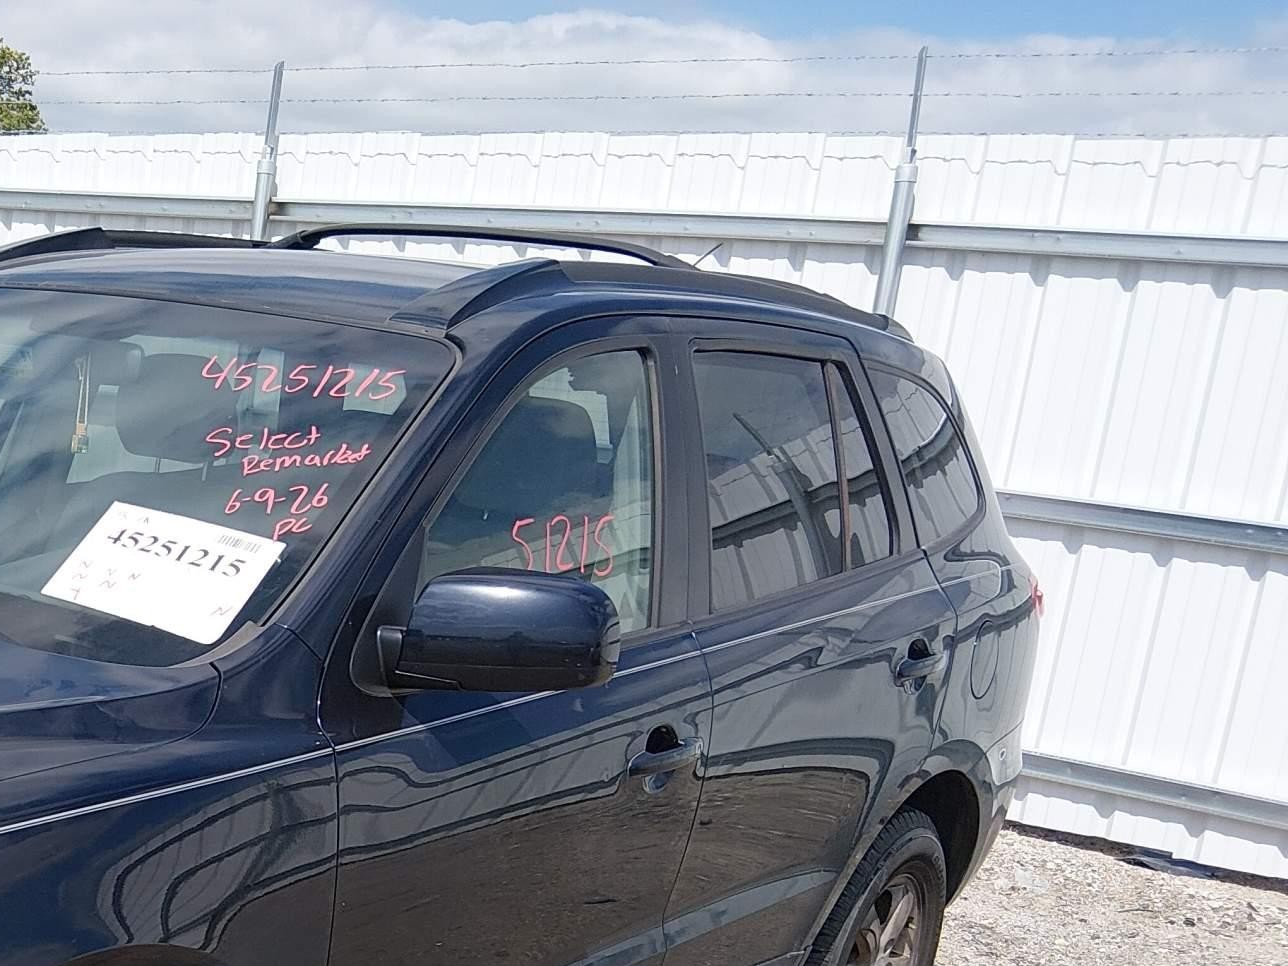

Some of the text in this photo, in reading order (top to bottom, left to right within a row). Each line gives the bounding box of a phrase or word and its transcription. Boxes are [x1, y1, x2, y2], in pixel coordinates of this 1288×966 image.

[201, 355, 406, 400] 45251215
[205, 425, 321, 457] Select
[242, 443, 372, 476] Remarket
[224, 483, 329, 514] 6-9-26
[106, 528, 247, 577] 45251215
[512, 514, 615, 577] 51215
